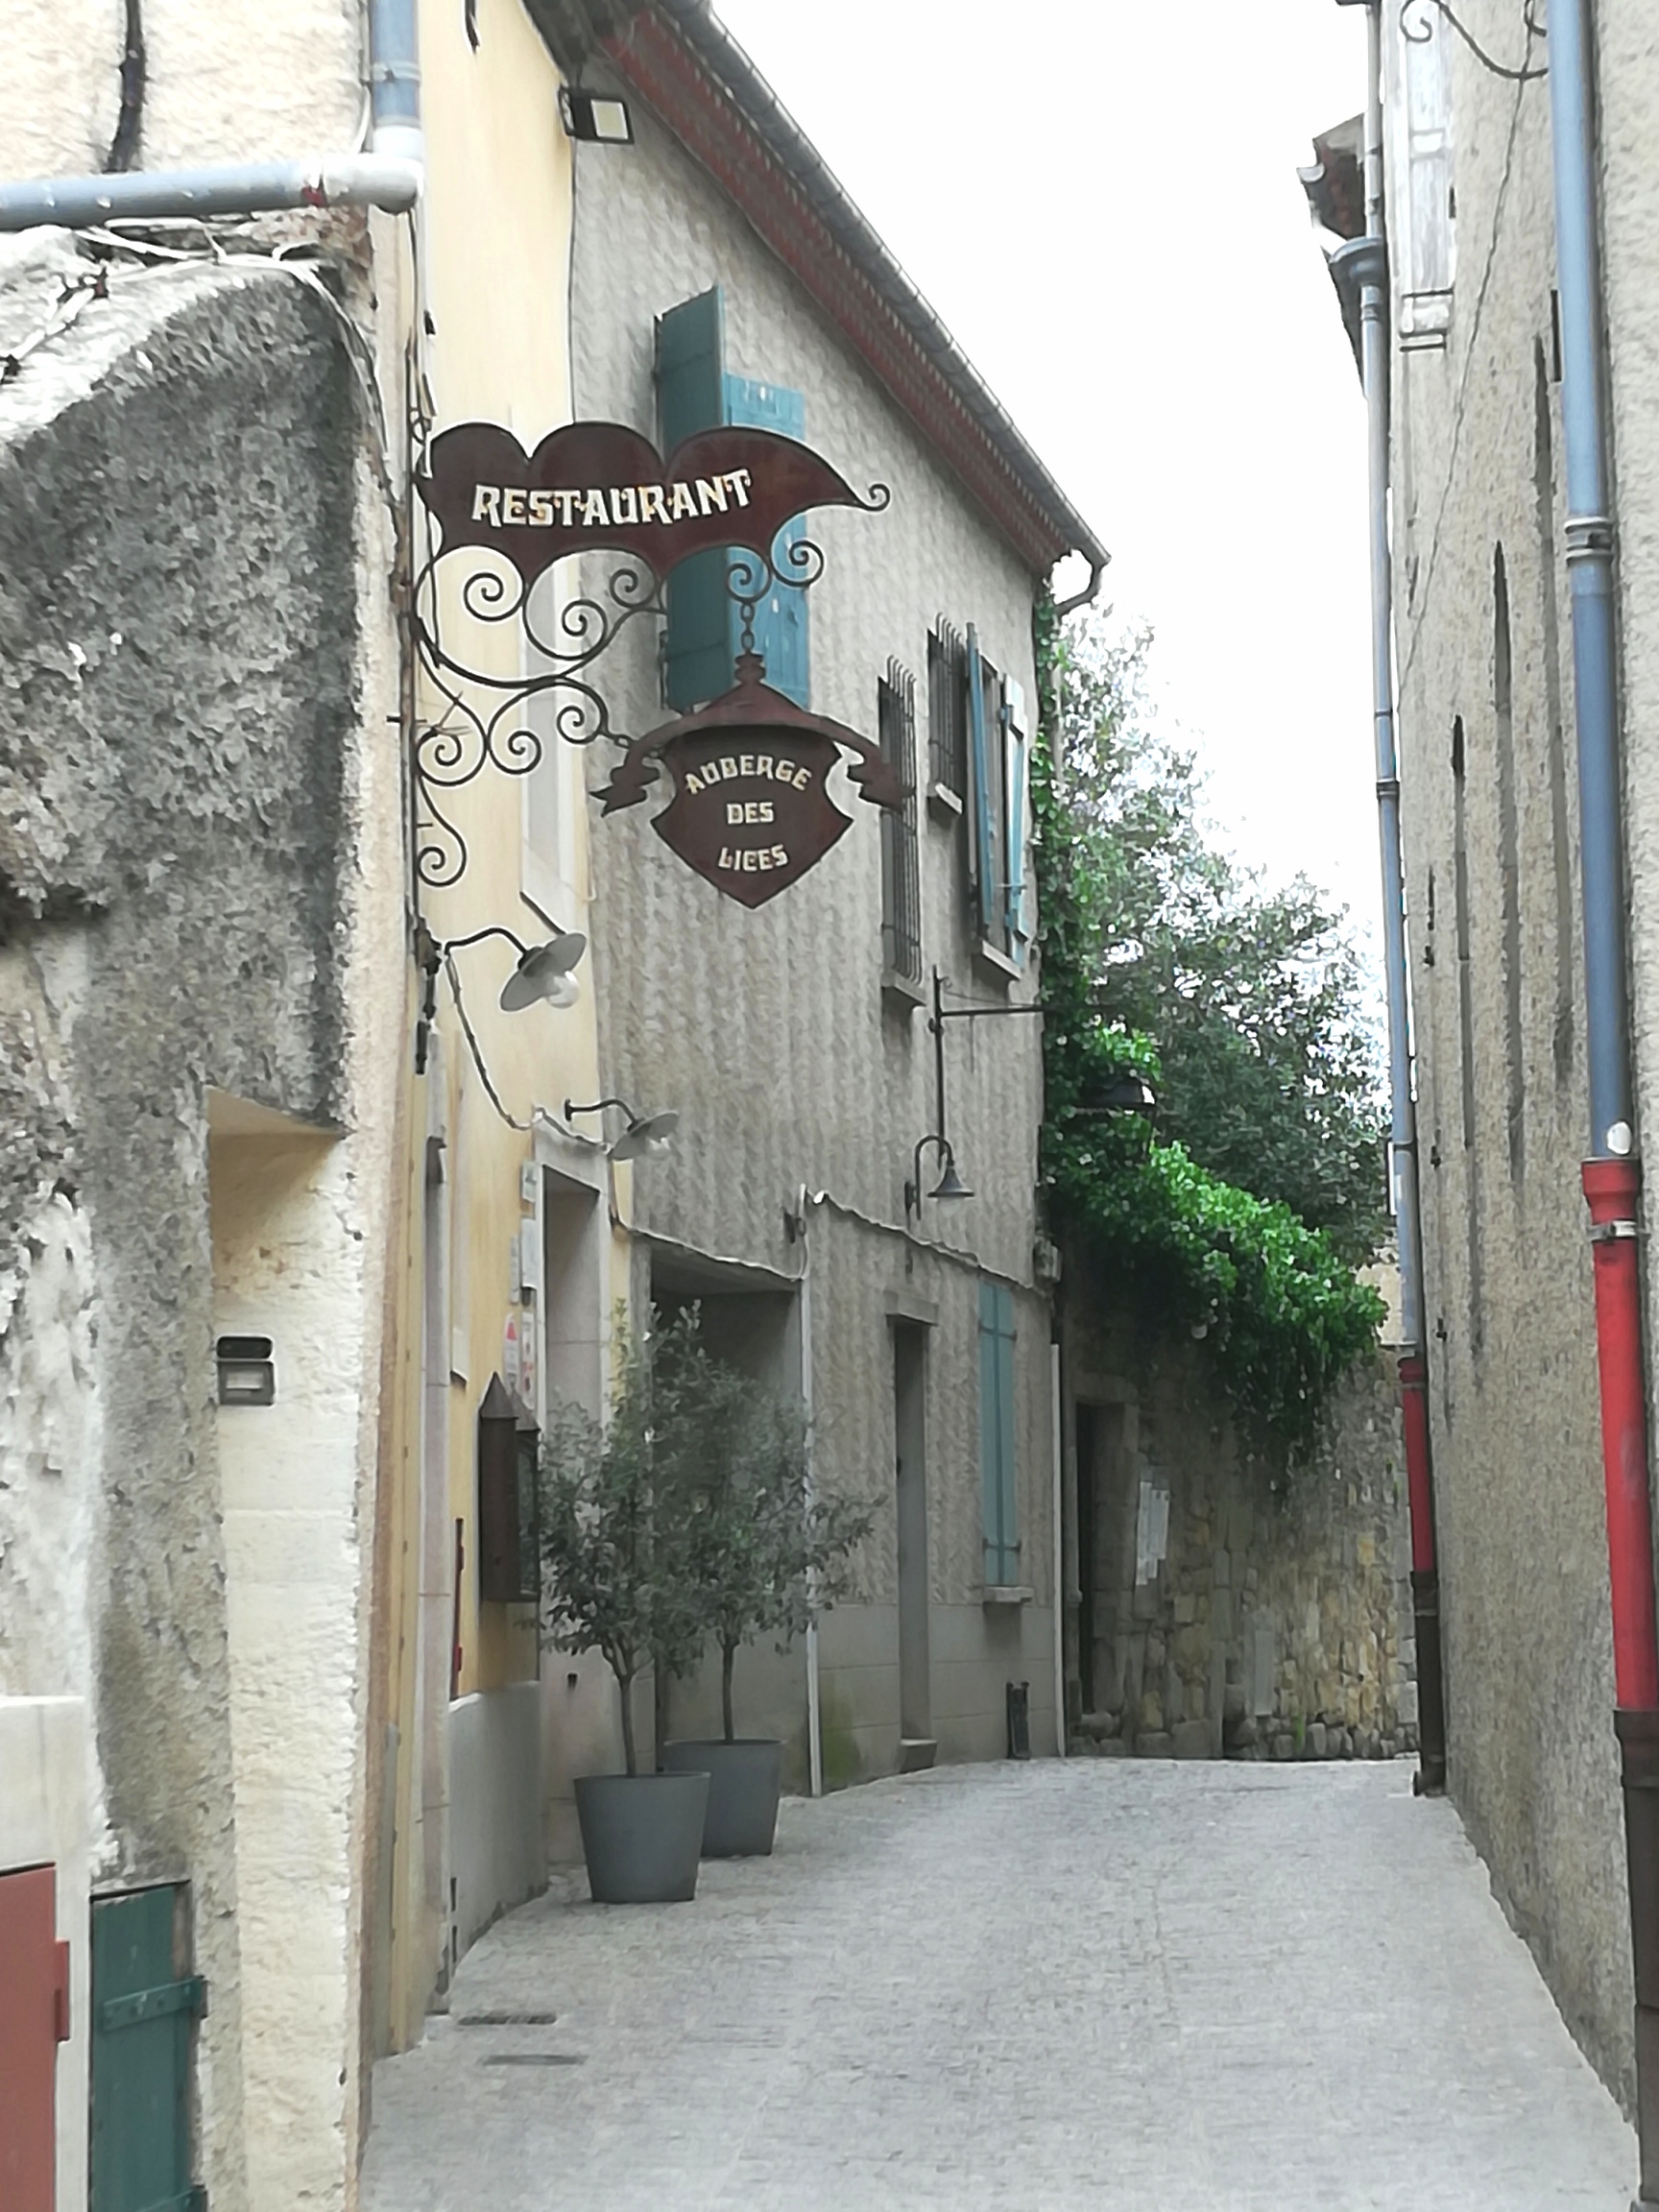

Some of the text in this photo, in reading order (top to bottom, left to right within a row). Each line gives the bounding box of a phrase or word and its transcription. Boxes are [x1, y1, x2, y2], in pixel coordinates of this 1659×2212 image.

[471, 469, 753, 527] RESTAURANT
[685, 755, 812, 794] AUBERGE
[727, 802, 775, 825] DES
[718, 845, 788, 872] LICES
